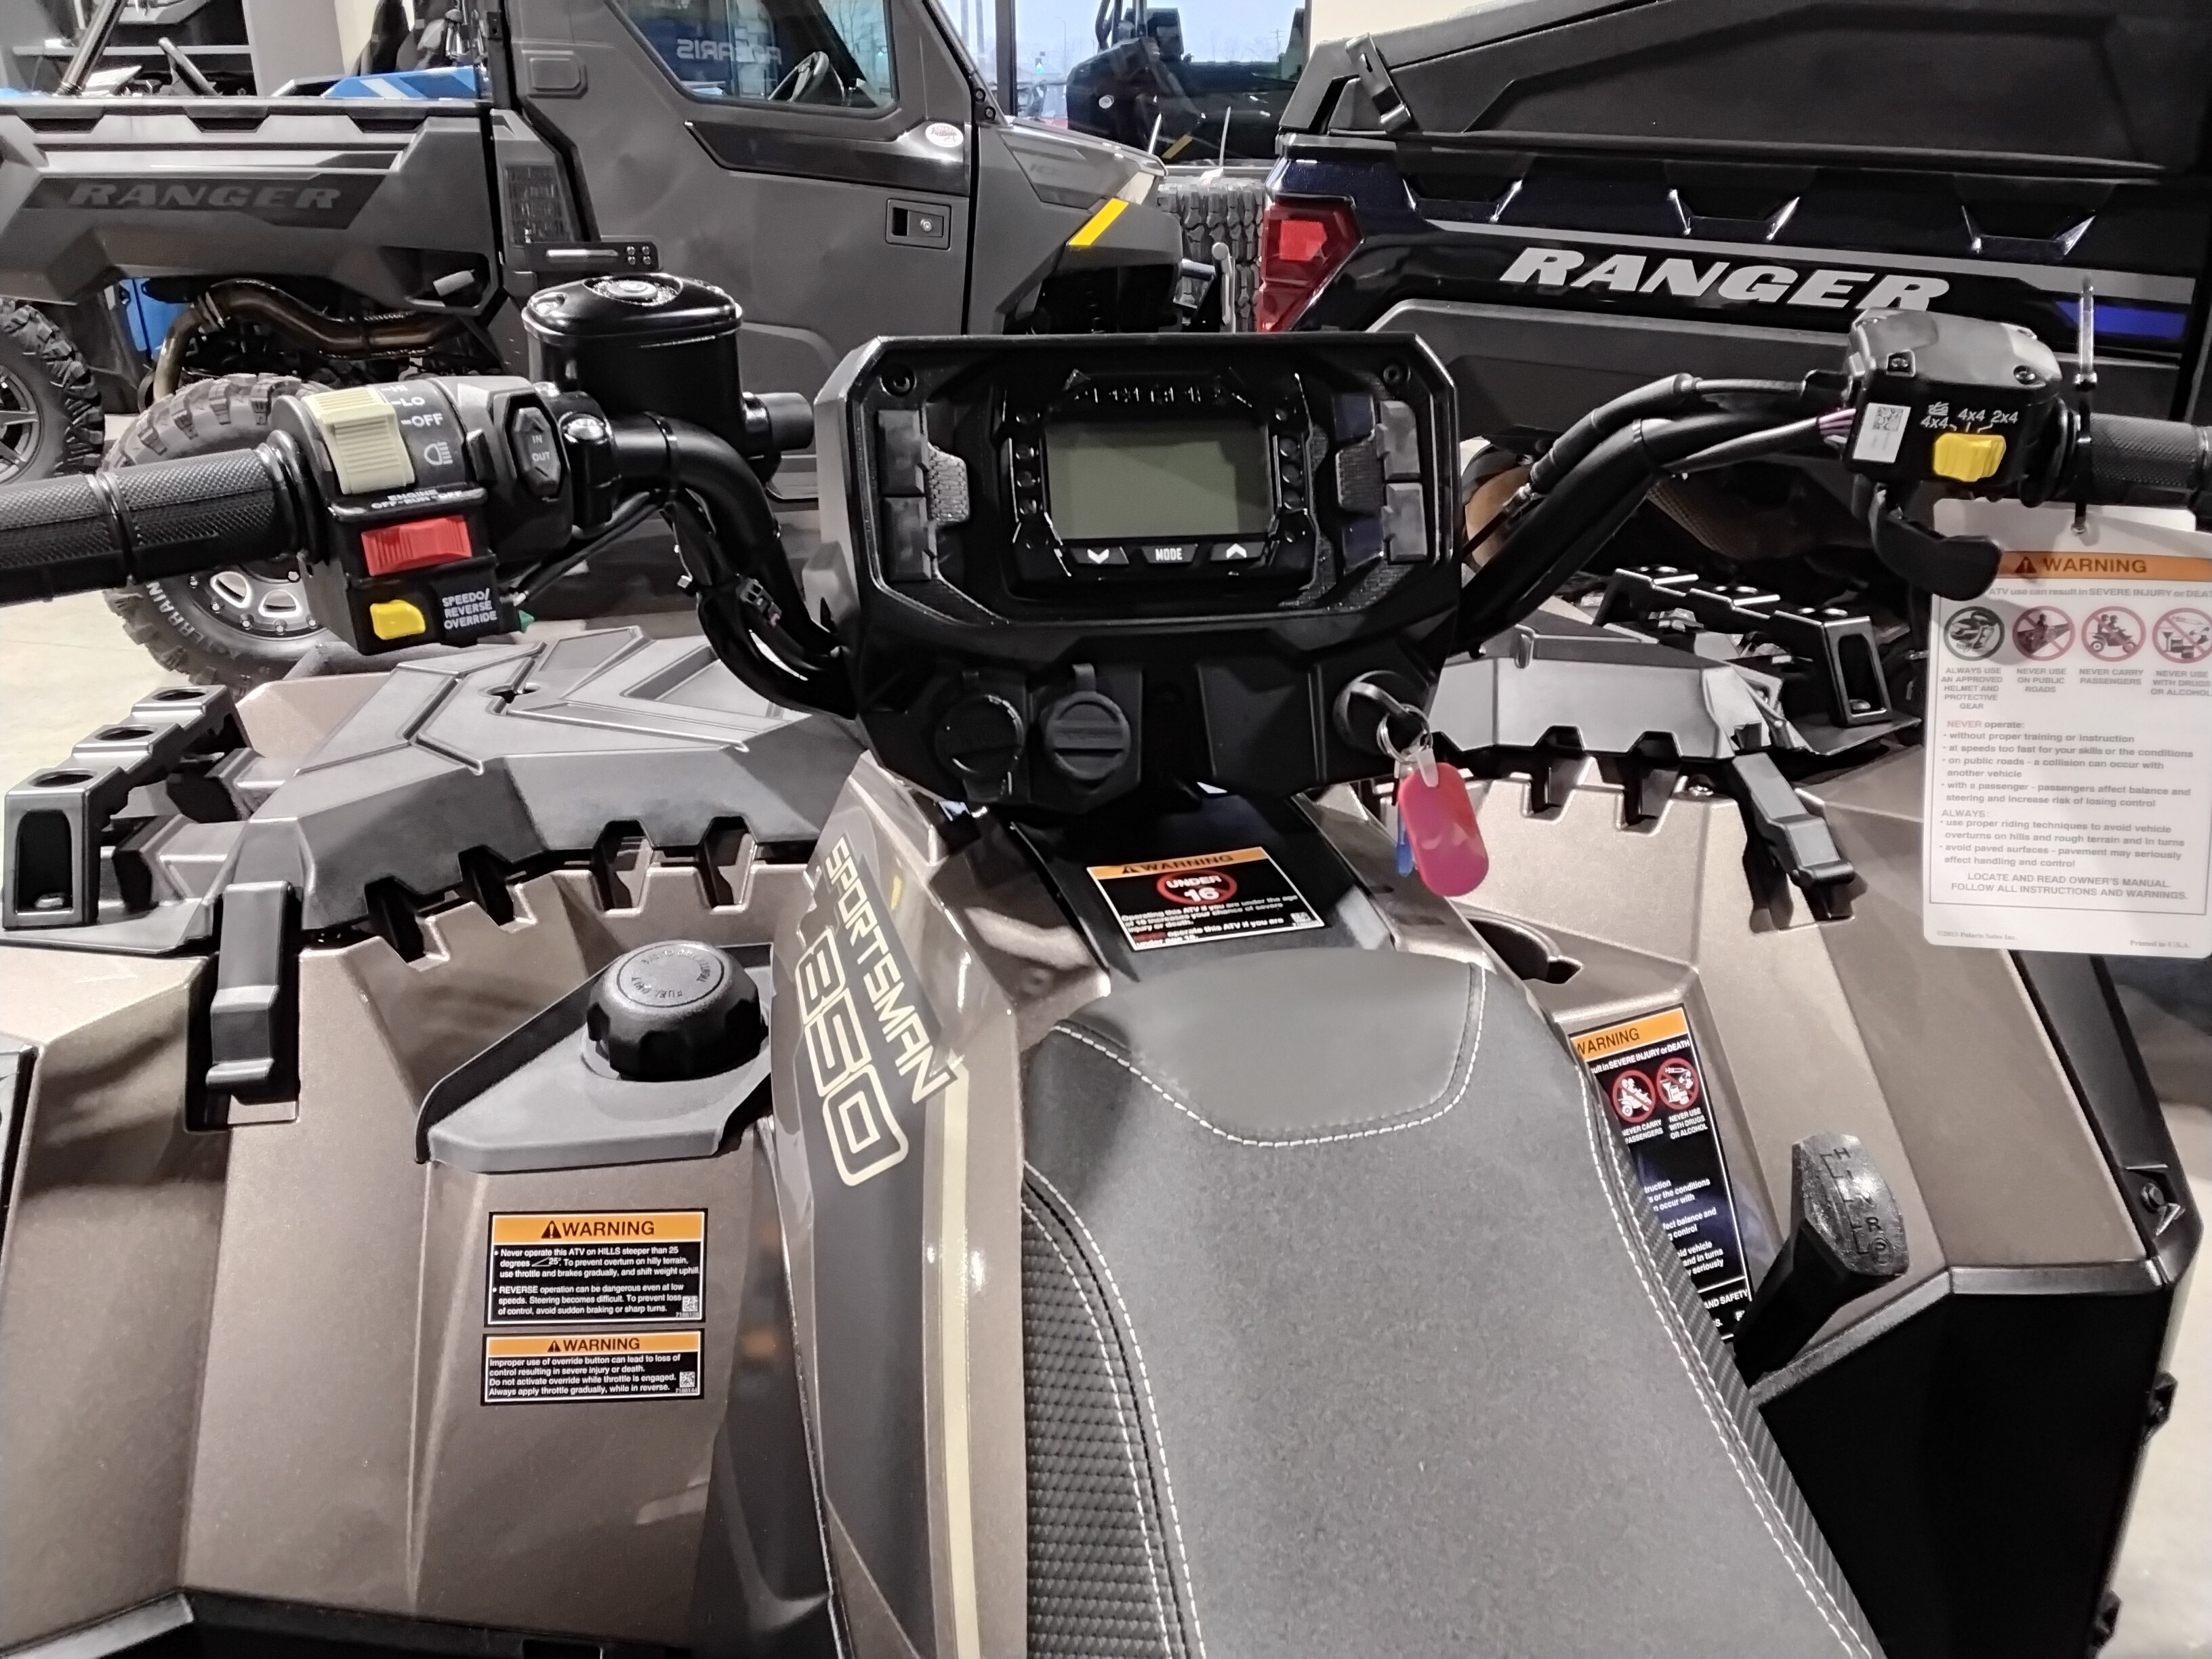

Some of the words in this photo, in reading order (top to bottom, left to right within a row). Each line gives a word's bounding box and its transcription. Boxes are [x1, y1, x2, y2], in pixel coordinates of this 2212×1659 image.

[68, 183, 341, 209] RANGER
[1499, 247, 1950, 311] RANGER
[400, 396, 426, 407] LO
[411, 413, 444, 428] OFF
[532, 434, 543, 444] IN
[532, 451, 551, 462] OUT
[387, 489, 439, 502] ENGINE
[1155, 547, 1183, 561] MODE
[2043, 556, 2147, 573] WARNING
[2184, 590, 2212, 598] DEA
[444, 599, 493, 619] REVERSE
[443, 610, 498, 631] OVERRIDE
[2016, 667, 2047, 675] NEVER
[2155, 670, 2188, 678] NEVER
[1949, 731, 1986, 739] without
[1988, 733, 2022, 741] proper
[2023, 733, 2062, 742] training
[2078, 734, 2135, 743] instruction
[1141, 855, 1234, 872] WARNING
[1166, 875, 1222, 888] UNDER
[1184, 887, 1220, 902] 16
[825, 836, 959, 1105] SPORTSMAN
[655, 988, 683, 999] FUEL
[795, 928, 909, 1187] 850
[1590, 1065, 1602, 1073] ult
[1608, 1055, 1636, 1068] SEVERE
[1635, 1048, 1660, 1061] INJURY
[1667, 1040, 1689, 1051] DEATH
[1668, 1111, 1689, 1122] NEVER
[1669, 1122, 1684, 1130] WITH
[1685, 1115, 1705, 1126] DRUGS
[1641, 1120, 1662, 1130] CARRY
[1680, 1123, 1708, 1136] ALCOHOL
[561, 1221, 655, 1237] WARNING
[500, 1248, 523, 1256] Never
[553, 1248, 567, 1256] this
[568, 1247, 586, 1256] ATV
[597, 1246, 621, 1255] HILLS
[668, 1246, 679, 1254] 25
[499, 1260, 531, 1269] degrees
[562, 1258, 574, 1266] To
[646, 1256, 661, 1266] hilly
[662, 1256, 689, 1265] terrain,
[514, 1269, 541, 1277] throttle
[541, 1269, 556, 1277] and
[556, 1269, 583, 1277] brakes
[583, 1268, 619, 1278] gradually,
[620, 1268, 636, 1276] and
[636, 1267, 653, 1275] shift
[653, 1267, 678, 1276] weight
[678, 1266, 701, 1275] uphill.
[498, 1285, 538, 1294] REVERSE
[601, 1284, 641, 1293] dangerous
[661, 1283, 670, 1291] at
[1719, 1289, 1748, 1303] SAFETY
[562, 1337, 640, 1351] WARNING
[489, 1359, 525, 1368] Improper
[541, 1357, 550, 1366] of
[551, 1357, 583, 1365] override
[584, 1356, 610, 1364] button
[627, 1355, 644, 1363] lead
[655, 1354, 671, 1362] loss
[672, 1353, 681, 1361] of
[489, 1368, 516, 1376] control
[518, 1367, 552, 1376] resulting
[588, 1366, 610, 1374] injury
[621, 1364, 645, 1373] death.
